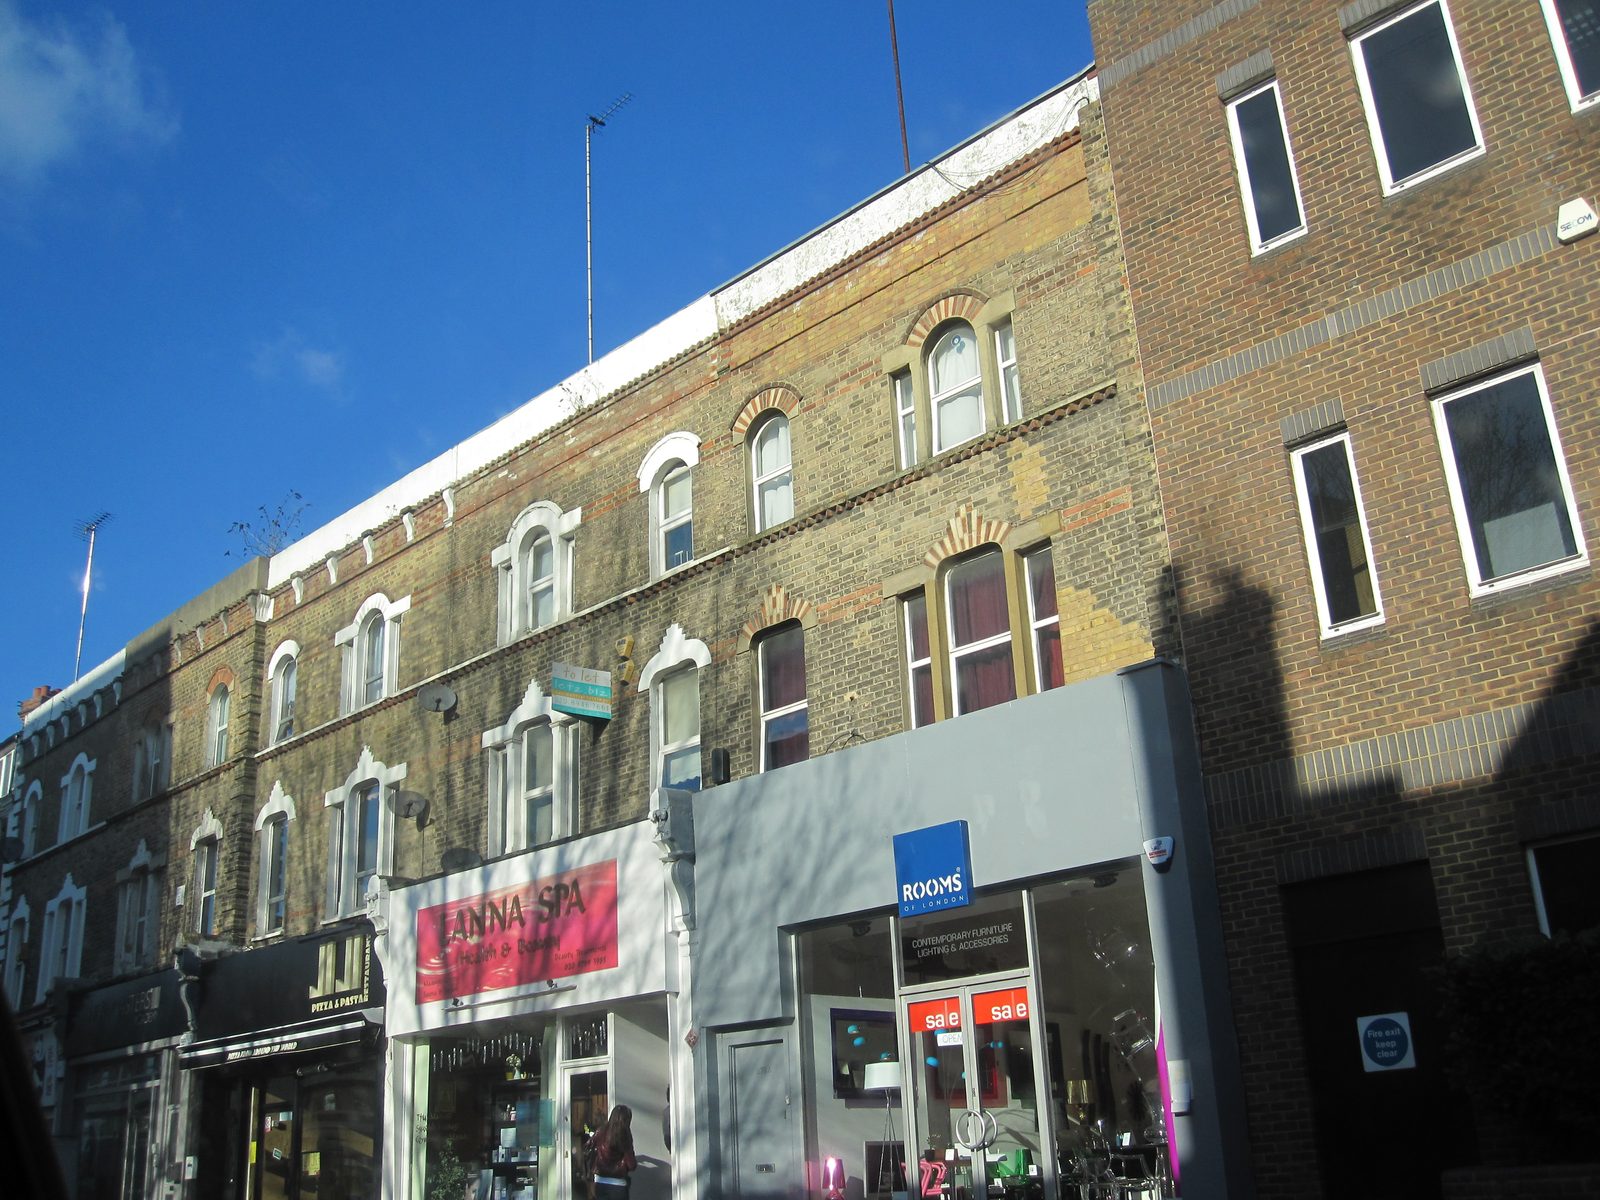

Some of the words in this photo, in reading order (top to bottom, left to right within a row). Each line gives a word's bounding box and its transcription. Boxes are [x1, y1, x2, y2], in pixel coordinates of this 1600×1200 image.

[581, 670, 600, 685] let
[902, 873, 962, 902] ROOMS
[440, 894, 525, 946] LANNA
[538, 878, 586, 923] SPA
[923, 896, 964, 909] LONDON
[912, 931, 971, 949] CONTEMPORARY
[972, 923, 1013, 936] FURNITURE
[501, 943, 511, 958] &
[917, 945, 950, 958] LIGHTING
[951, 944, 957, 952] &
[959, 934, 1009, 950] ACCESSORIES
[312, 1000, 333, 1013] PIZZA
[334, 998, 340, 1009] &
[340, 994, 364, 1008] PASTA
[991, 991, 1027, 1020] sale
[926, 1001, 959, 1028] sale
[1367, 1030, 1383, 1038] Fire
[1385, 1028, 1400, 1037] exit
[1375, 1040, 1396, 1049] keep
[1377, 1050, 1397, 1058] clear
